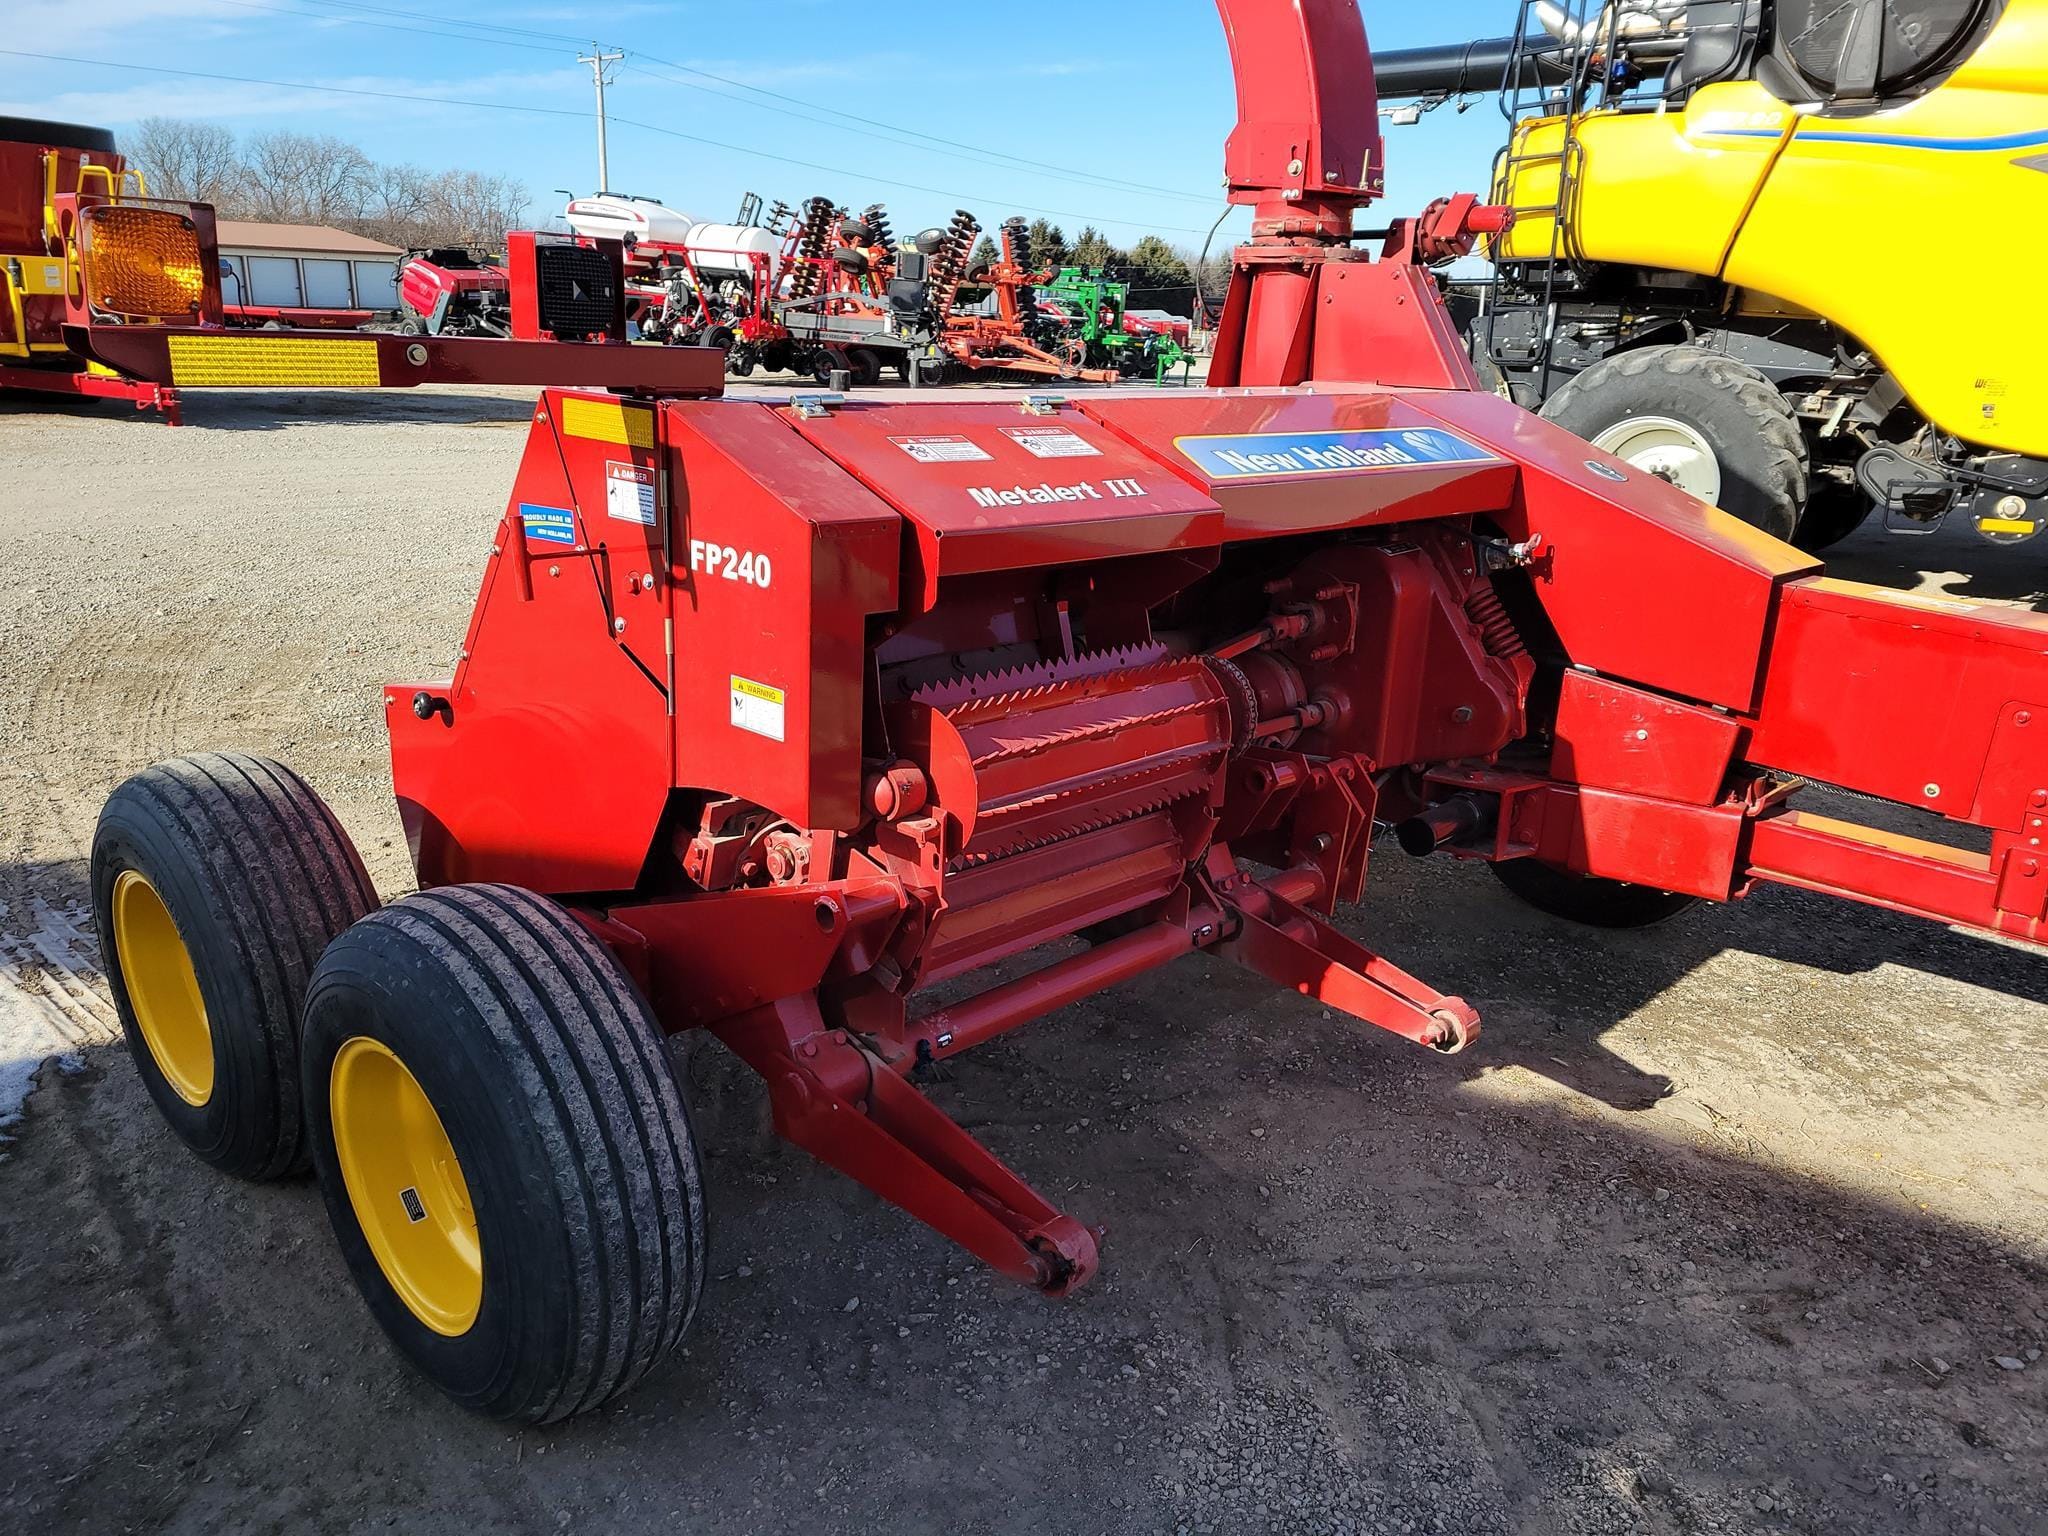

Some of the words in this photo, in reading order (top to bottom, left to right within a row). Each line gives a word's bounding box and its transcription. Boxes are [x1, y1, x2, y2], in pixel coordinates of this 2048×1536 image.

[1212, 447, 1305, 473] New
[1300, 442, 1417, 469] Holland
[621, 469, 648, 482] DANGER
[966, 480, 1104, 508] Metalert
[1101, 478, 1149, 499] III
[690, 538, 771, 589] FP240
[746, 683, 776, 700] WARNING
